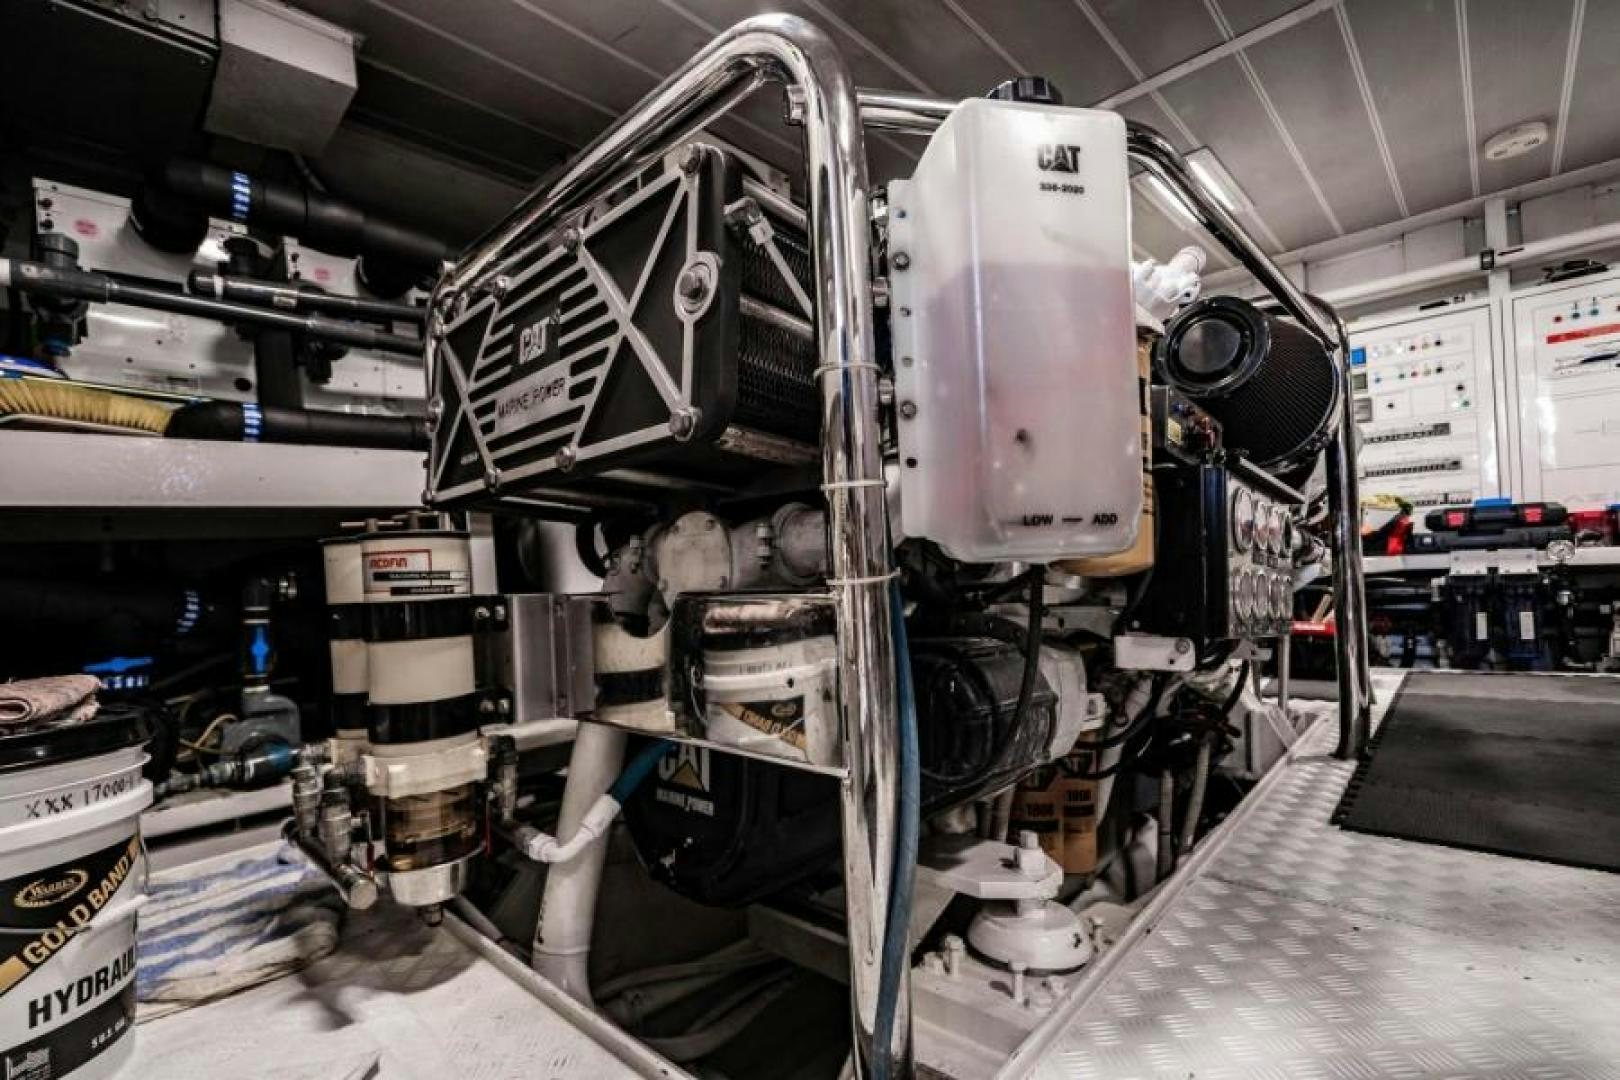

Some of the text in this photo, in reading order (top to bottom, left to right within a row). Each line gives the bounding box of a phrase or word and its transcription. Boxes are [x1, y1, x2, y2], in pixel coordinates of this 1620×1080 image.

[1037, 144, 1081, 174] CAT
[519, 316, 549, 365] CAT
[1022, 512, 1119, 527] LOW ADD
[22, 856, 130, 965] GOLD BAND
